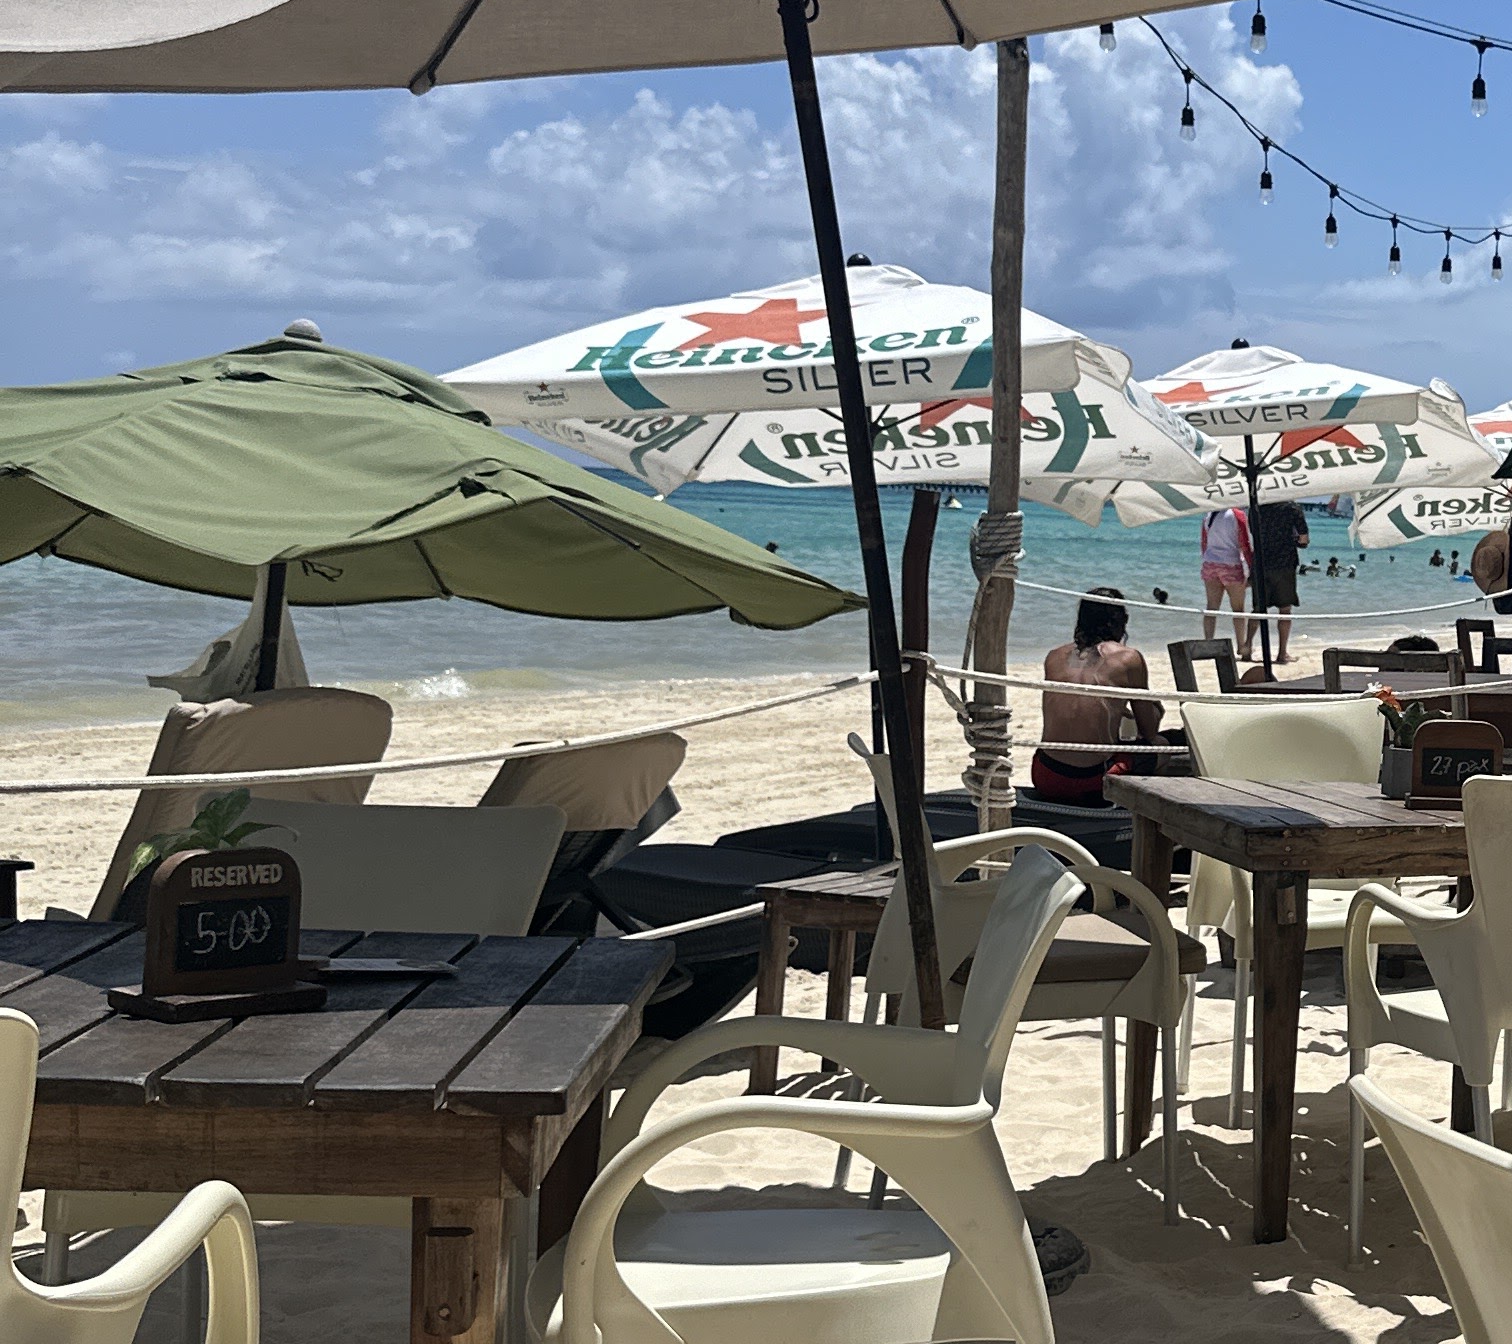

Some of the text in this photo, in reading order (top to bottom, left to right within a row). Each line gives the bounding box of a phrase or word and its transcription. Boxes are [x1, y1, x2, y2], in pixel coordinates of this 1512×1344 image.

[763, 357, 933, 393] SILER
[1184, 404, 1309, 427] SILVER
[191, 863, 283, 888] RESERVED
